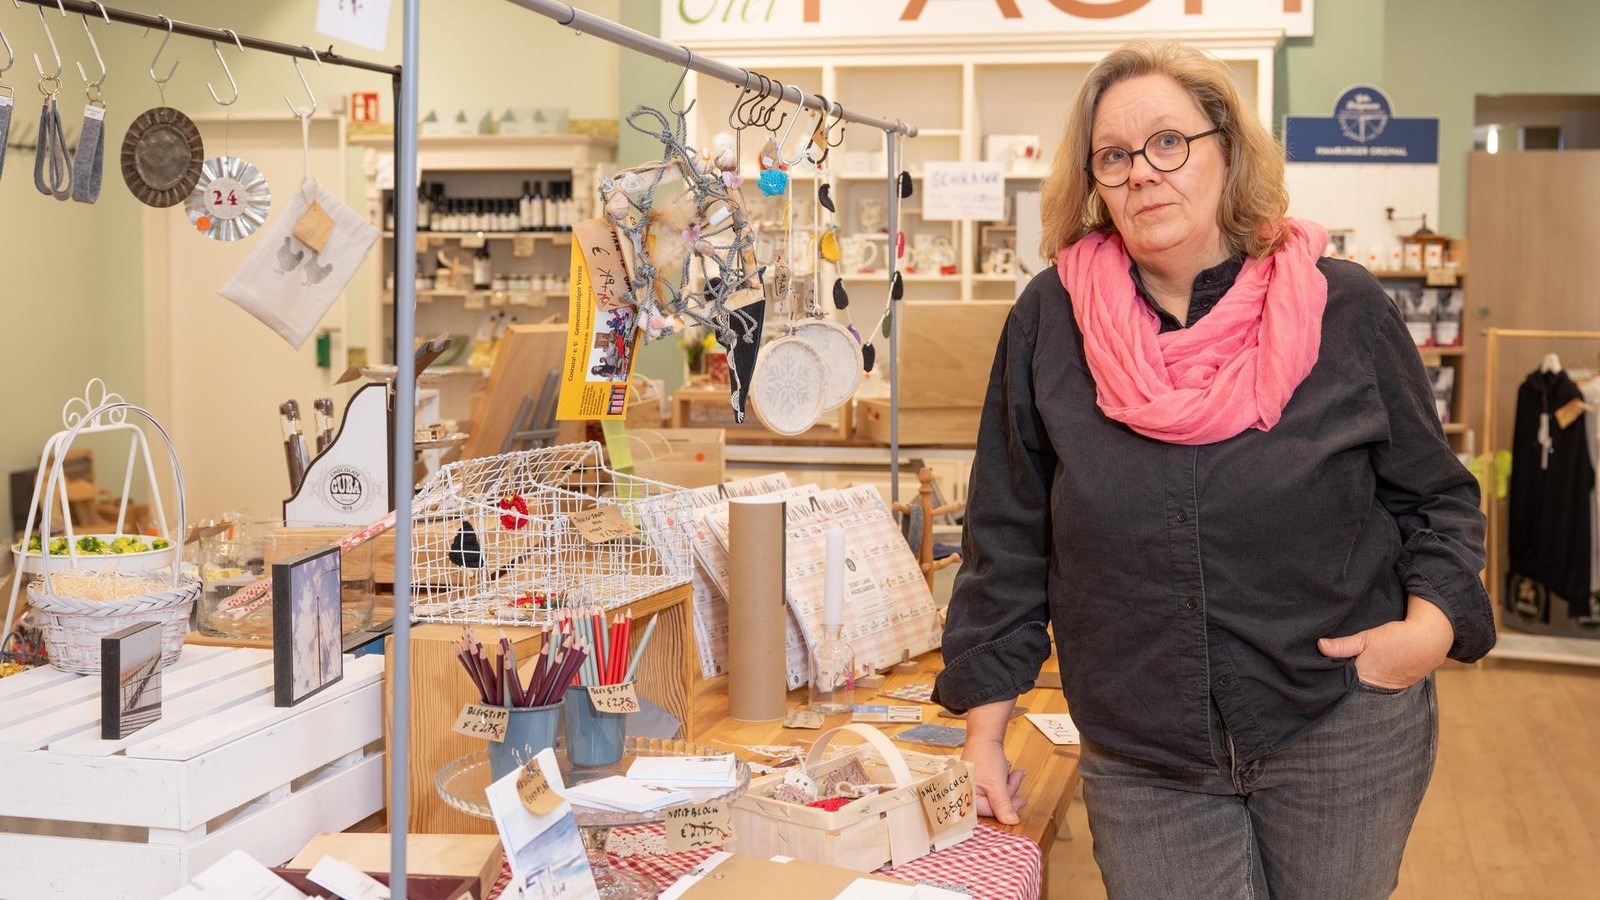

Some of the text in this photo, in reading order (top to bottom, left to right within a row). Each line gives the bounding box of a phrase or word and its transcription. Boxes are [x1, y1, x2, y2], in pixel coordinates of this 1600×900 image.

[213, 189, 238, 206] 24
[568, 356, 578, 382] Costura!
[574, 287, 583, 336] Gemeinnütziger
[330, 467, 360, 477] CHOCOLATE
[331, 474, 361, 494] CUBA
[467, 706, 507, 719] BLEISTIFT
